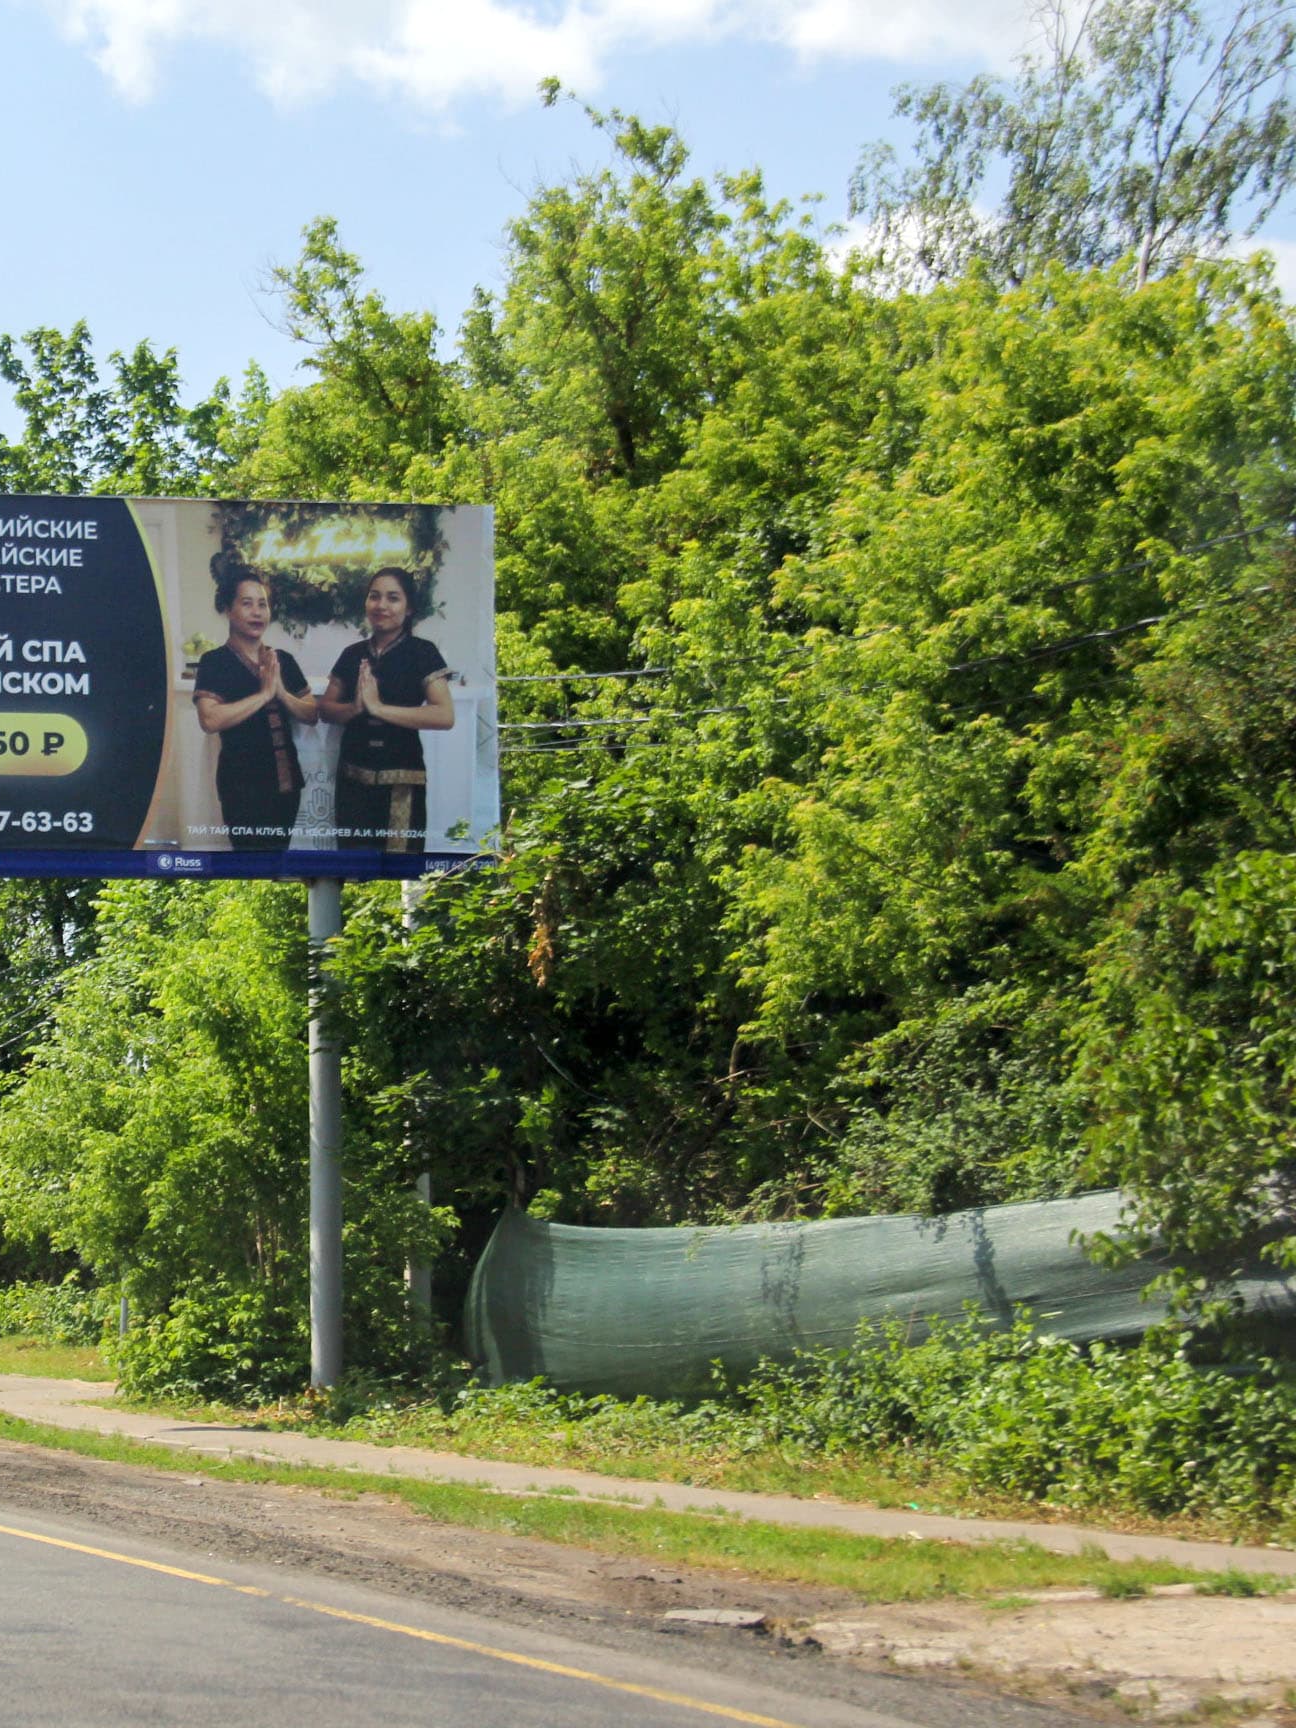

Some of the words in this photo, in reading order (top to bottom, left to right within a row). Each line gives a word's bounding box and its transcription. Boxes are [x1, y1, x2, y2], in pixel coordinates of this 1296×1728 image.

[22, 641, 87, 663] СПА
[187, 825, 207, 835] ТАЙ
[209, 825, 229, 835] ТАЙ
[231, 826, 253, 836] СПА
[255, 826, 286, 837] КЛУБ,
[174, 857, 201, 867] Russ
